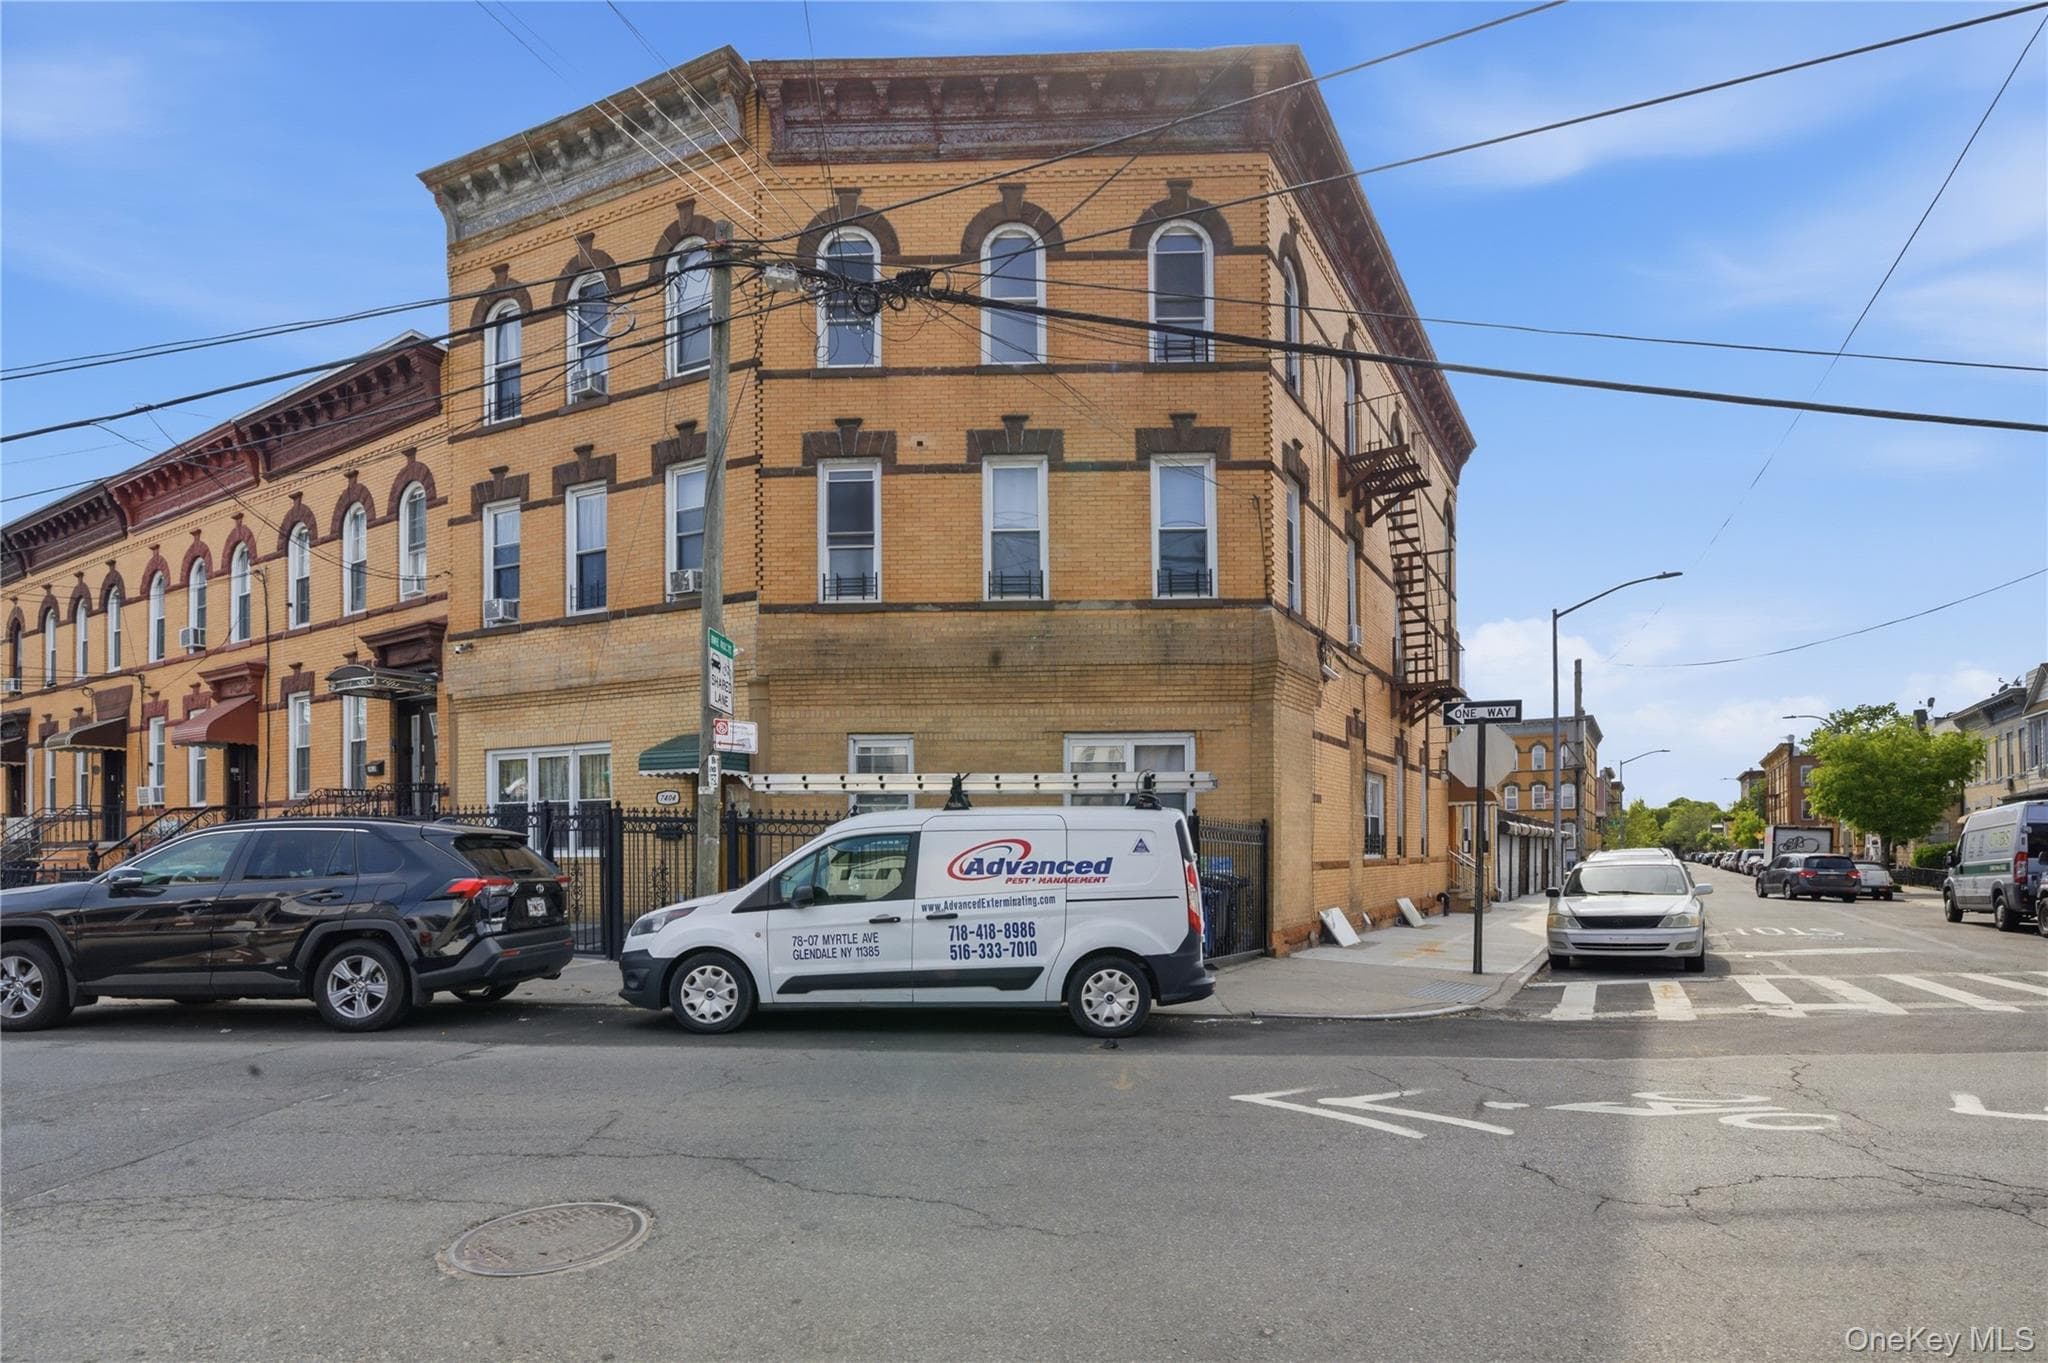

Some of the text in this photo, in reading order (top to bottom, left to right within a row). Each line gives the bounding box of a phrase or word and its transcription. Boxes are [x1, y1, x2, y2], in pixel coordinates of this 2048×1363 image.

[711, 673, 732, 694] SHARED
[714, 690, 729, 708] LANE
[1454, 707, 1512, 719] ONE WAY
[963, 856, 1114, 877] Advanced
[1005, 876, 1108, 885] PEST MANAGEMENT
[921, 895, 1056, 913] www.AdvancedExterminating.com
[792, 932, 879, 947] 78-07 MYRTLE AVE
[948, 921, 1036, 941] 718-418-8986
[792, 945, 880, 960] GLENDALE NY 11385
[950, 940, 1038, 960] 516-333-7010
